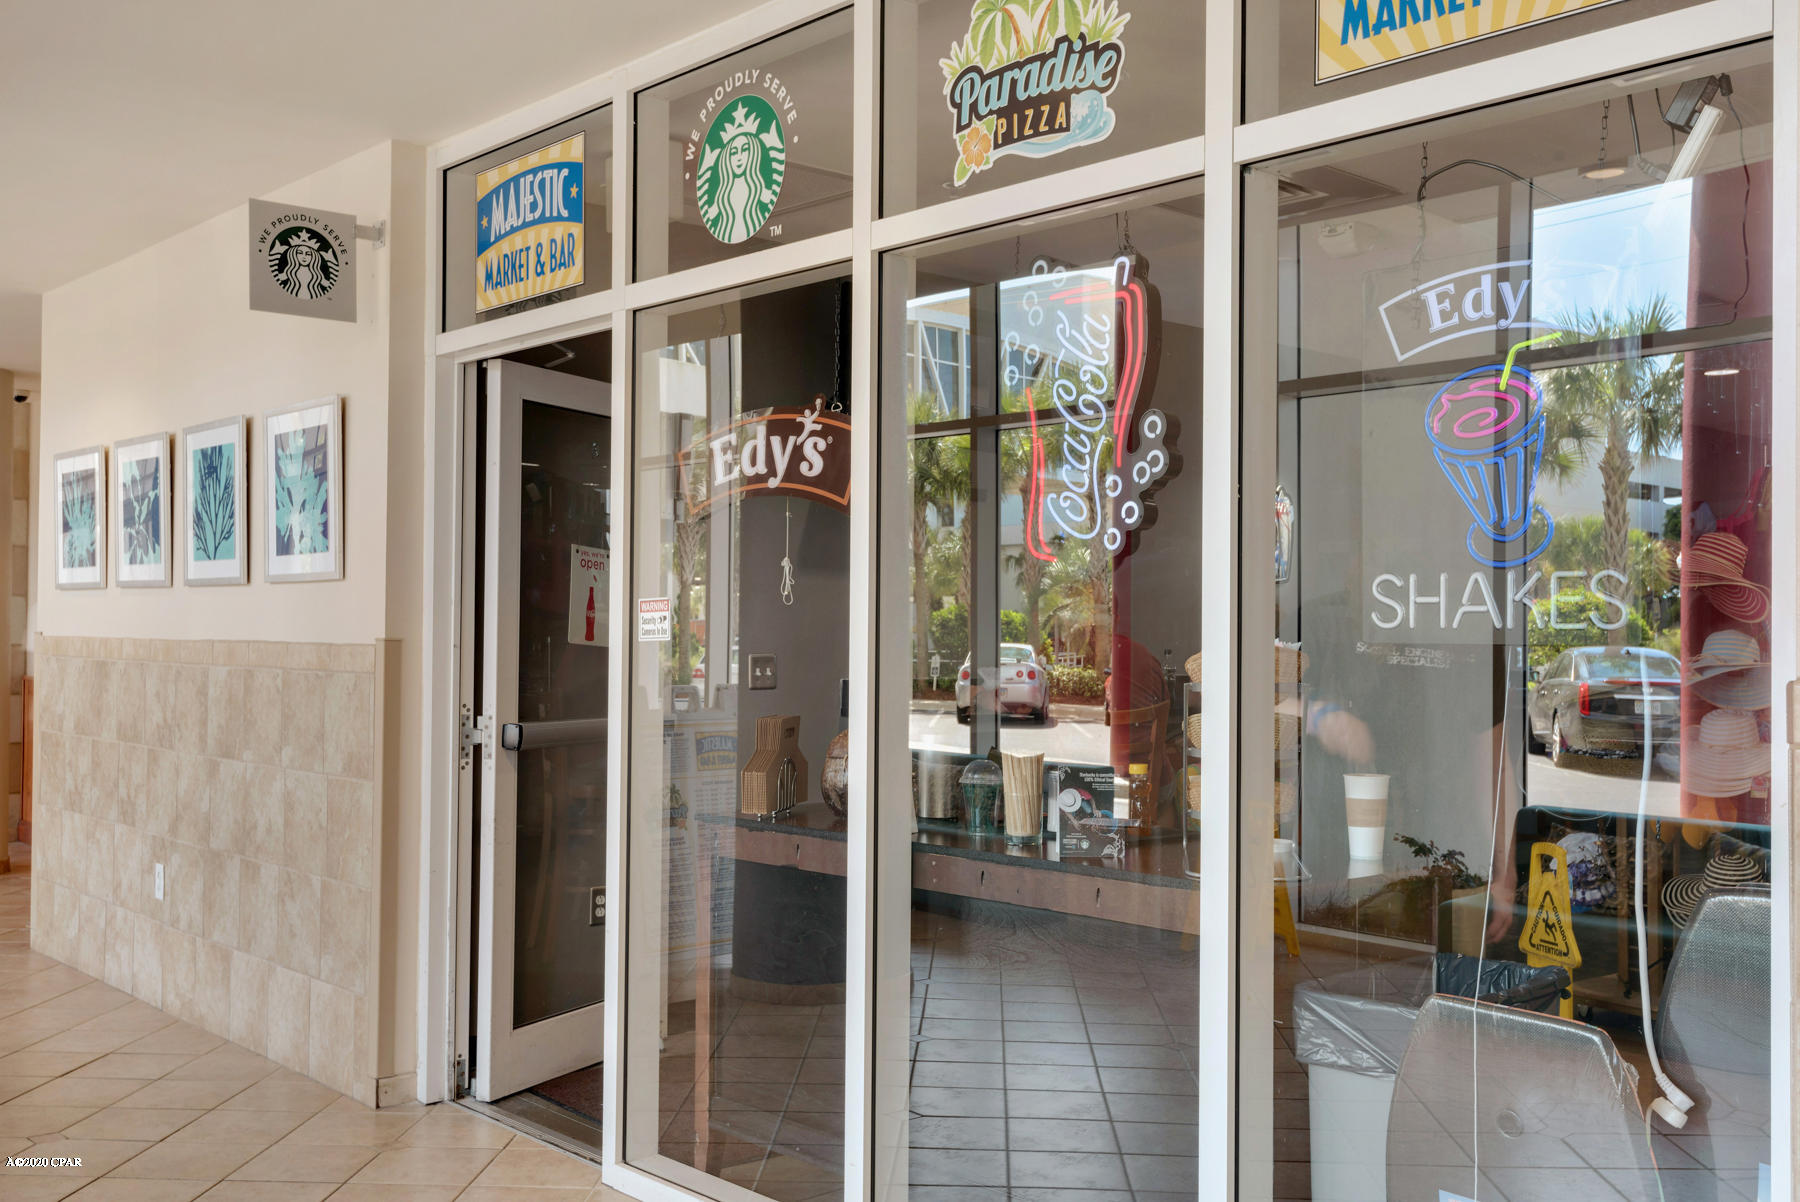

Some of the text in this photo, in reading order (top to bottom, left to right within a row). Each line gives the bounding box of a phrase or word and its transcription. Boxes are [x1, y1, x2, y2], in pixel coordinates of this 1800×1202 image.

[954, 39, 1118, 127] Paradise
[685, 69, 798, 161] WE PROUDLY SERVE
[997, 101, 1068, 145] PIZZA
[490, 167, 570, 243] MAJESTIC
[259, 213, 348, 256] WE PROUDLY SERVE
[484, 232, 576, 293] MARKET & BAR
[710, 423, 827, 488] Edy's
[580, 558, 605, 571] open
[640, 600, 668, 611] WARNING
[1371, 569, 1629, 630] SHAKES
[1531, 902, 1544, 934] CAUTION
[1552, 905, 1567, 943] CUIDADO
[1535, 943, 1563, 957] ATTENTION
